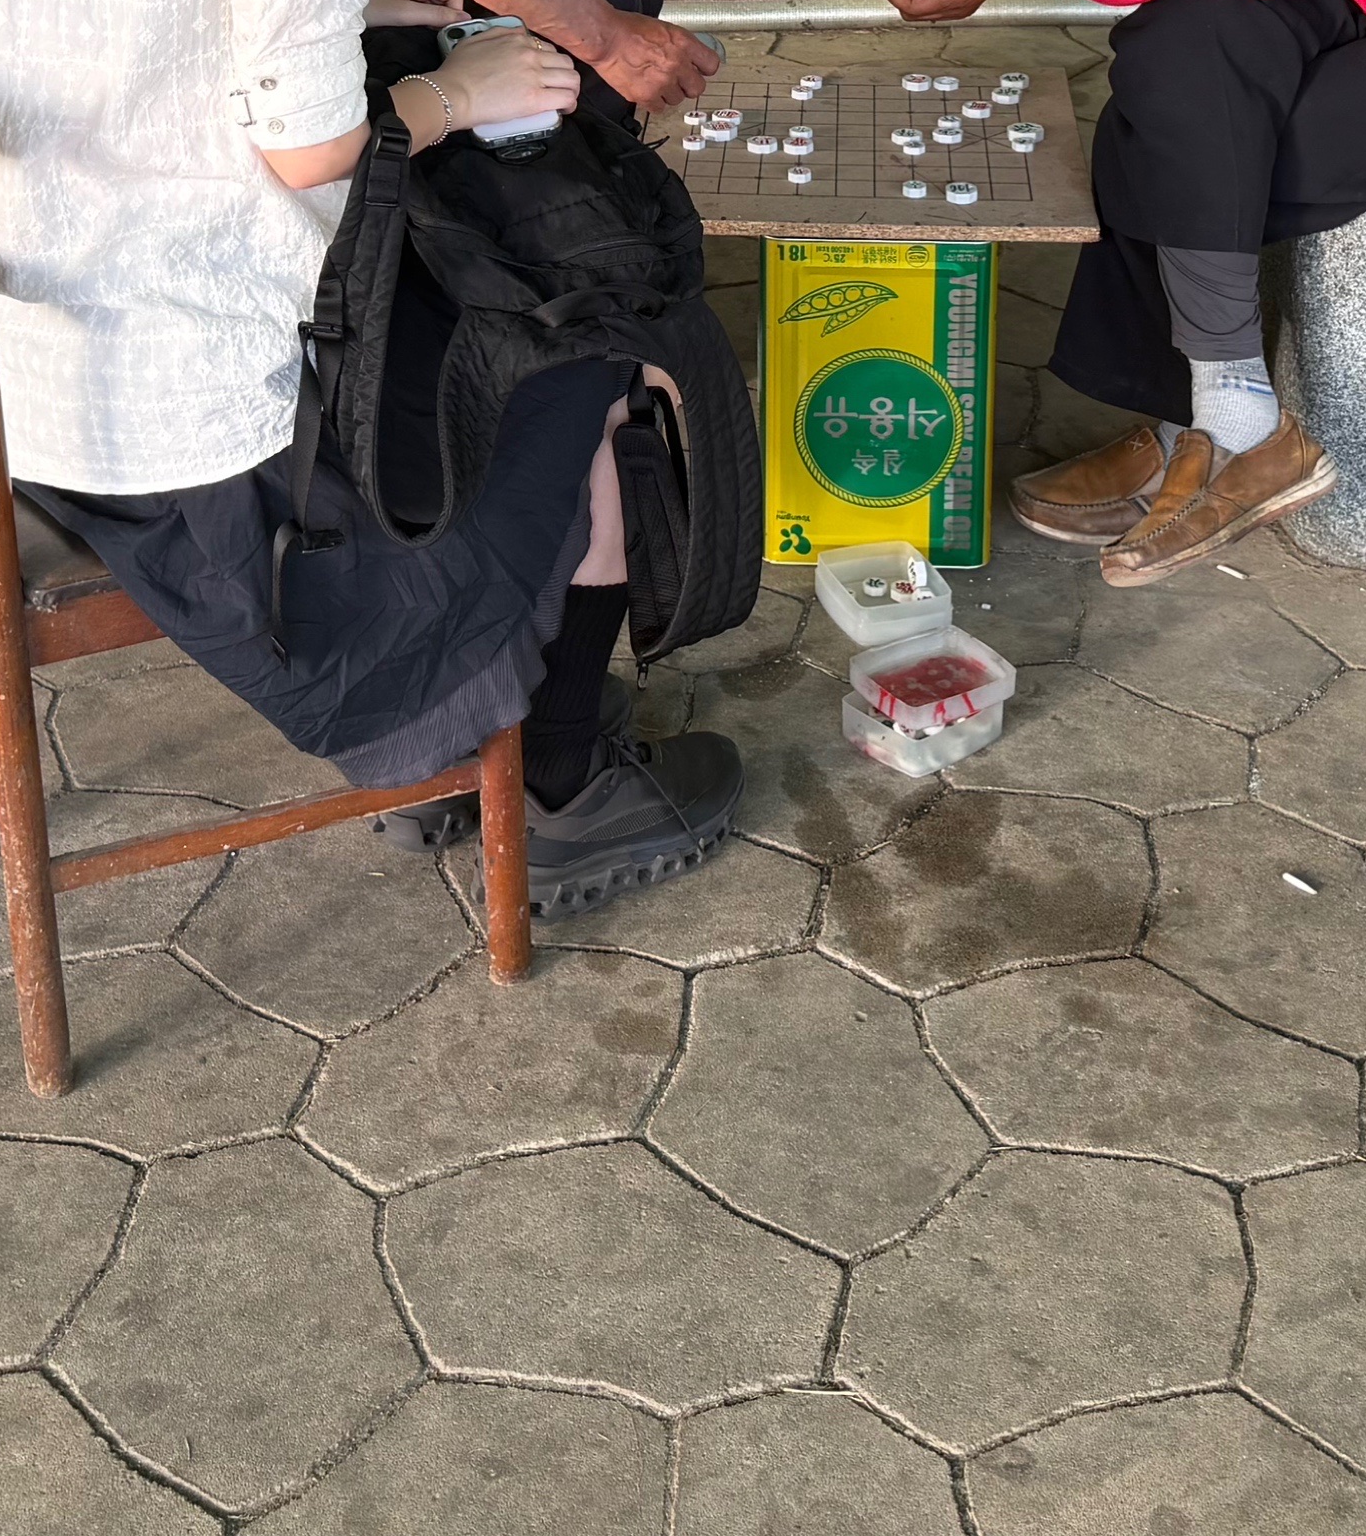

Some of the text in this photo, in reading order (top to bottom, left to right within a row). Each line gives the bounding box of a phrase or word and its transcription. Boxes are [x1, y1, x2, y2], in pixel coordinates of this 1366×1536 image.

[789, 245, 808, 262] 18
[947, 273, 978, 388] YOUNGMI
[813, 395, 947, 440] 식용유
[851, 449, 906, 476] 실속
[943, 515, 972, 552] OIL
